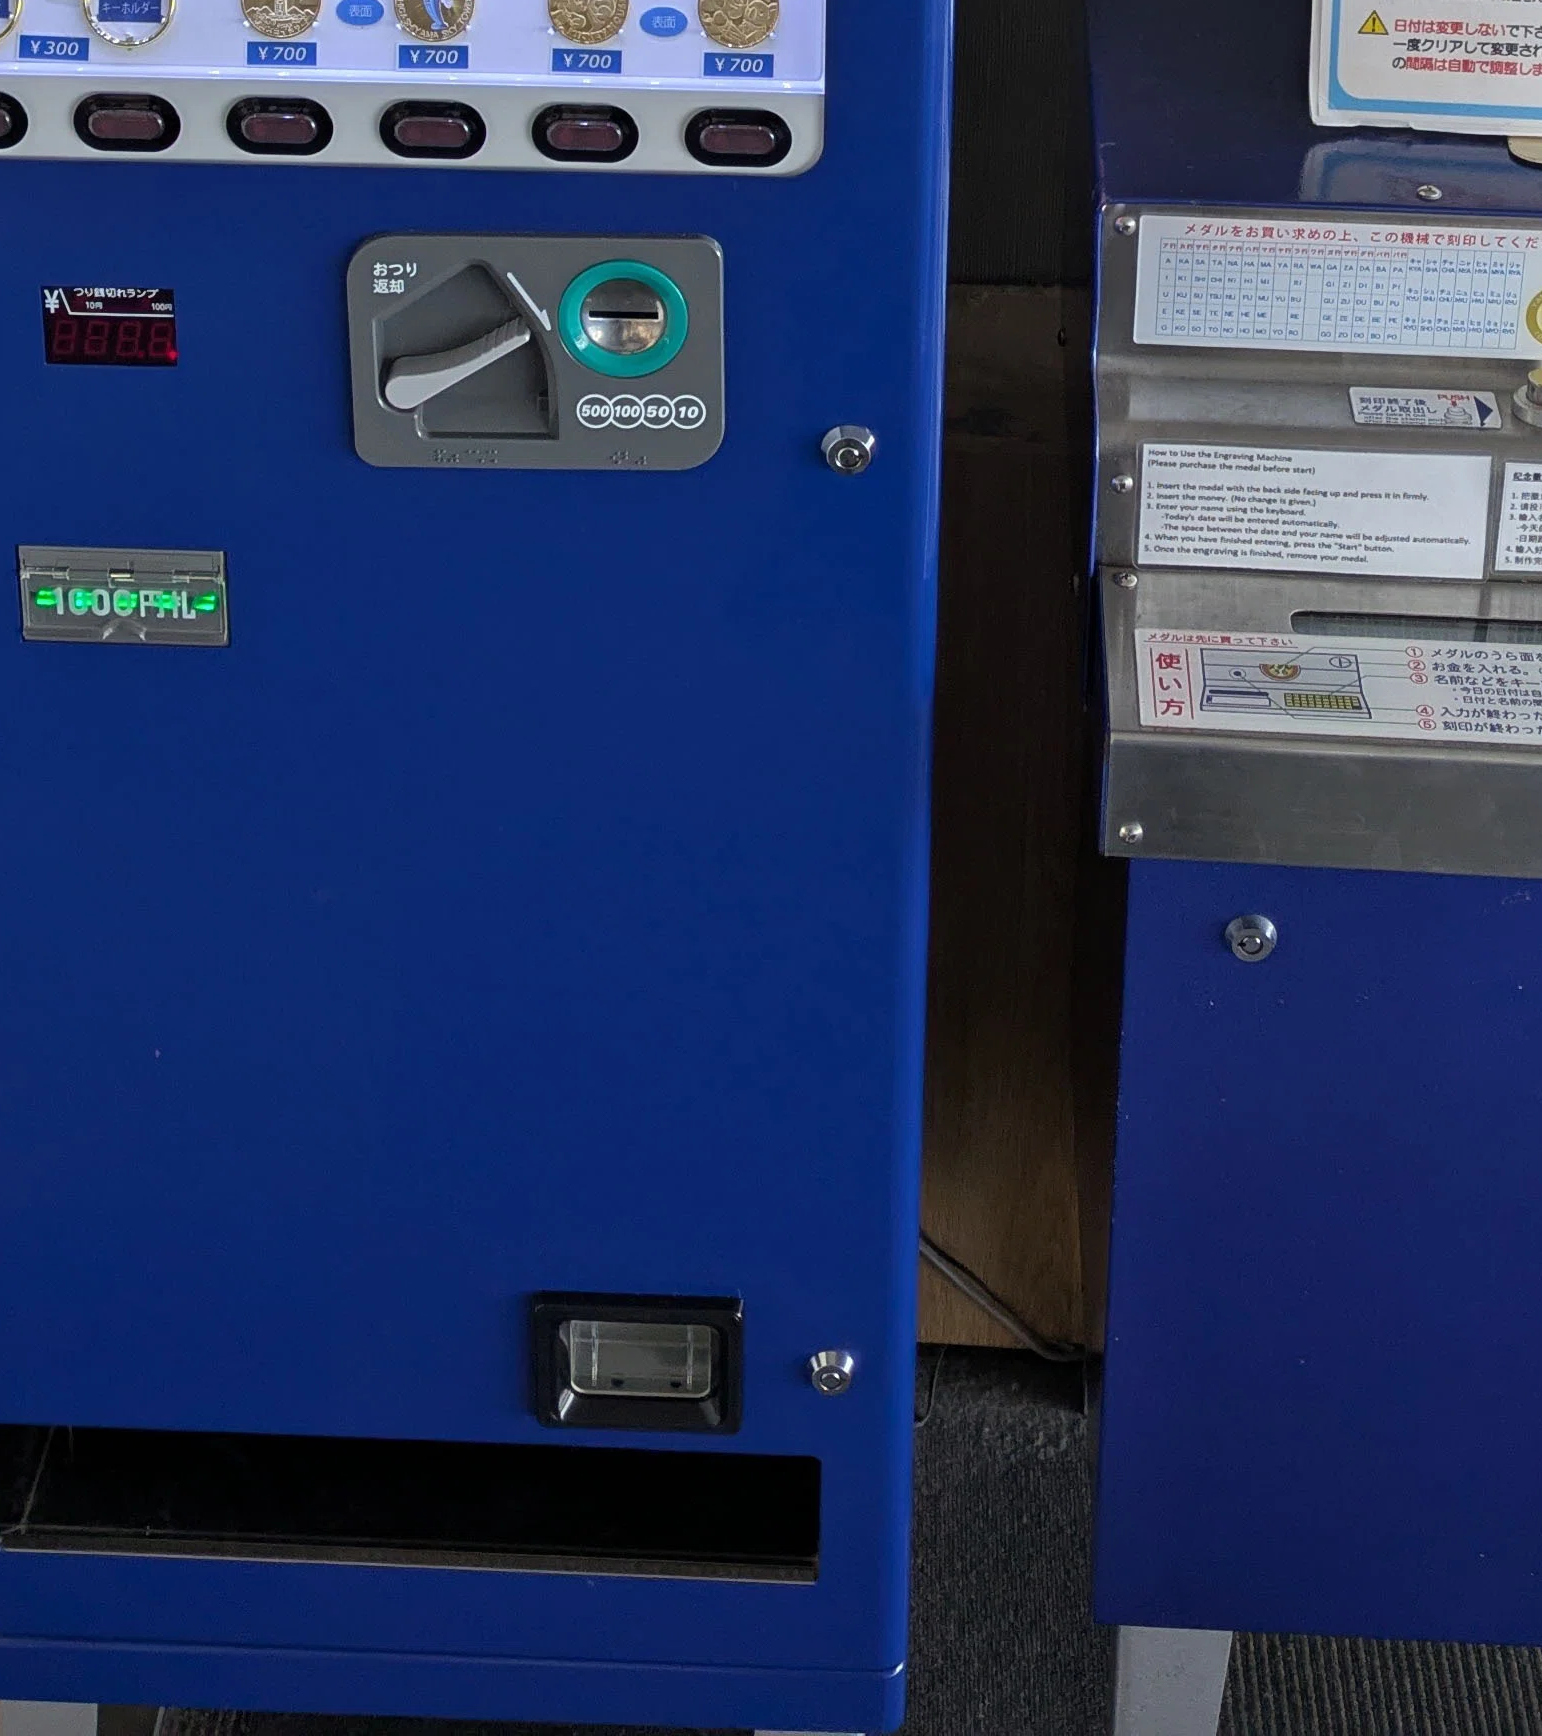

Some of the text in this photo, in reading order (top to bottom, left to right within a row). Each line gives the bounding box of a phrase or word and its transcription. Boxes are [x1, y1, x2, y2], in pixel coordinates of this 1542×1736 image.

[102, 2, 159, 14] キーホルダー
[372, 261, 418, 278] おつり
[74, 288, 159, 298] つり銭切れランプ
[372, 278, 405, 295] 返却
[579, 404, 699, 420] 500 100 50 10
[1361, 405, 1437, 414] メダル取出し
[1214, 452, 1254, 462] Engraving
[1257, 454, 1292, 462] Machine
[1180, 461, 1216, 470] purchase
[1263, 464, 1290, 472] before
[1293, 466, 1315, 474] start)
[1148, 633, 1292, 645] メダルは先に買って下さい
[1432, 661, 1529, 675] お金を入れる。
[1156, 653, 1185, 716] 使い方
